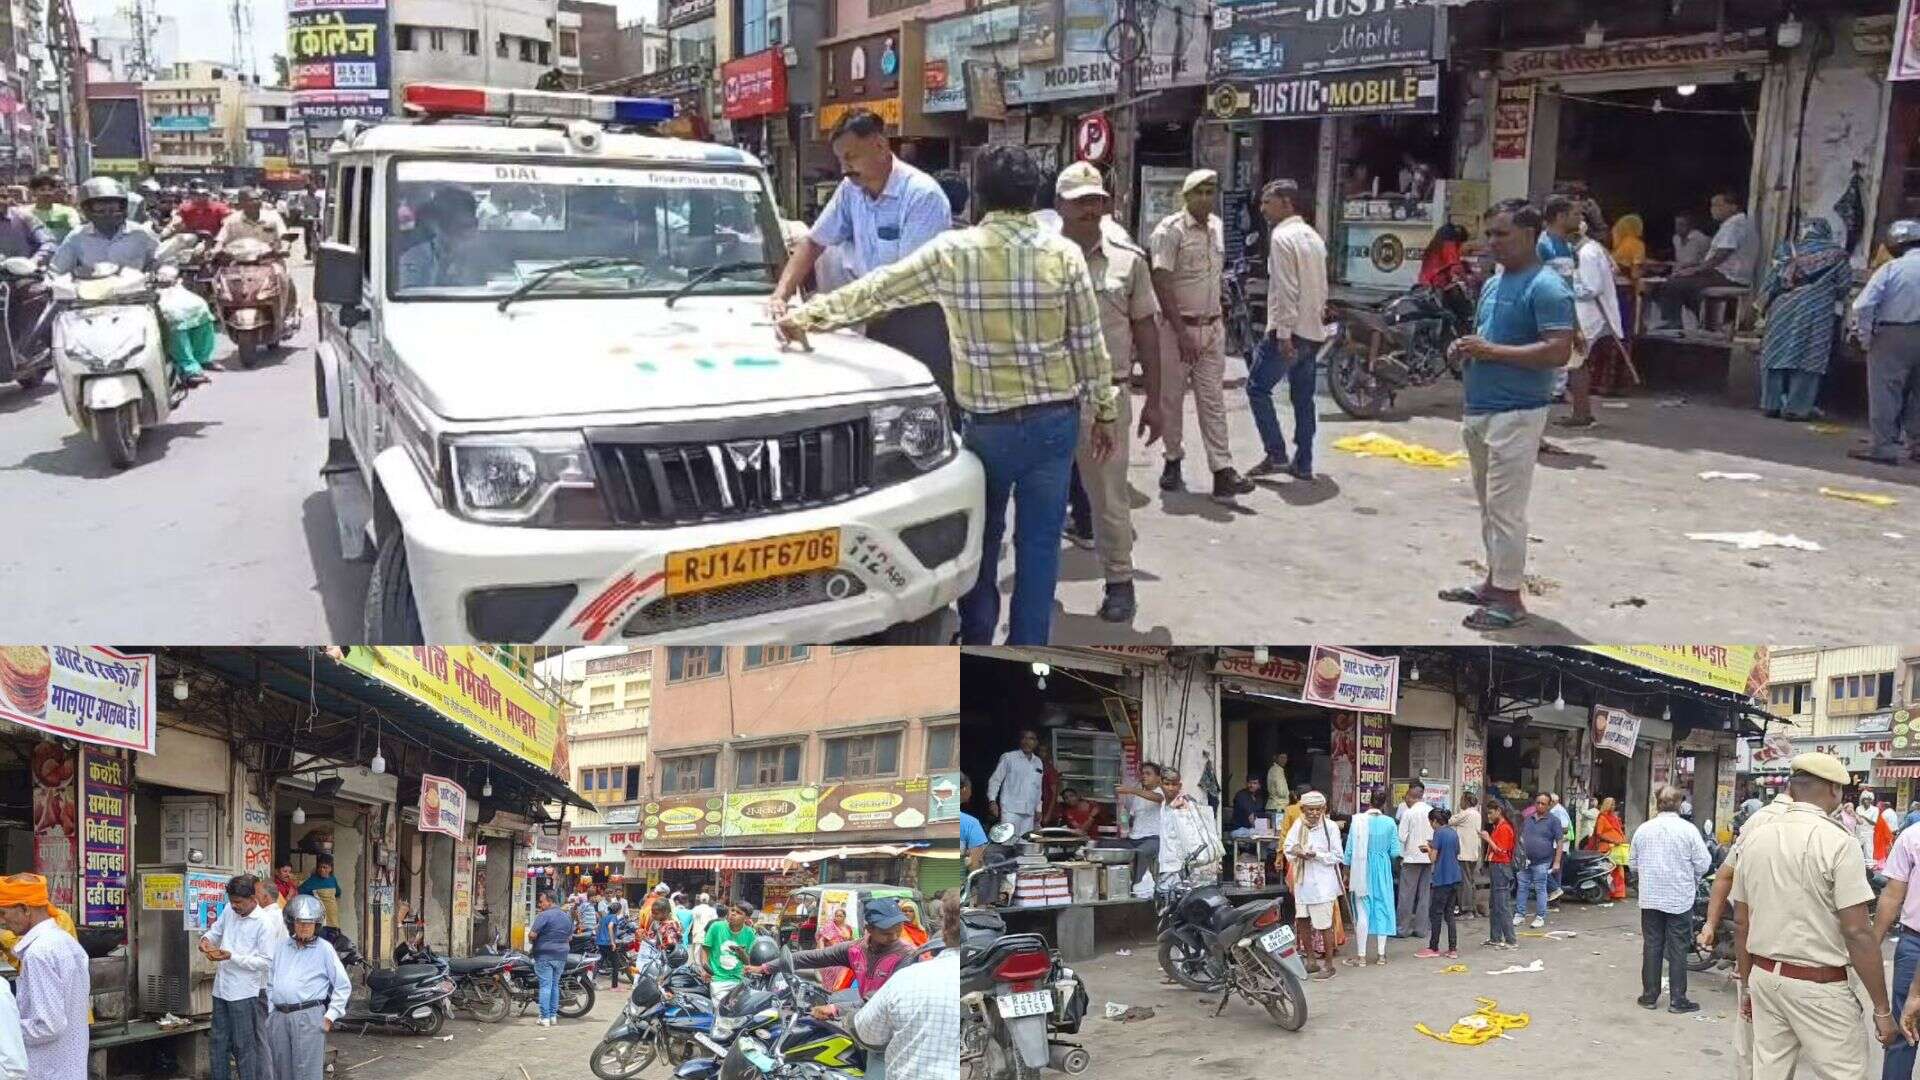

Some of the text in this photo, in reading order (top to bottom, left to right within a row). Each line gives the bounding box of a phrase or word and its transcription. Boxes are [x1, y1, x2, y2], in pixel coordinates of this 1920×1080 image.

[1044, 61, 1112, 88] MODERN
[1251, 76, 1418, 115] JUSTIC MOBILE
[495, 166, 541, 181] DIAL
[684, 535, 835, 583] RJ14TF6706
